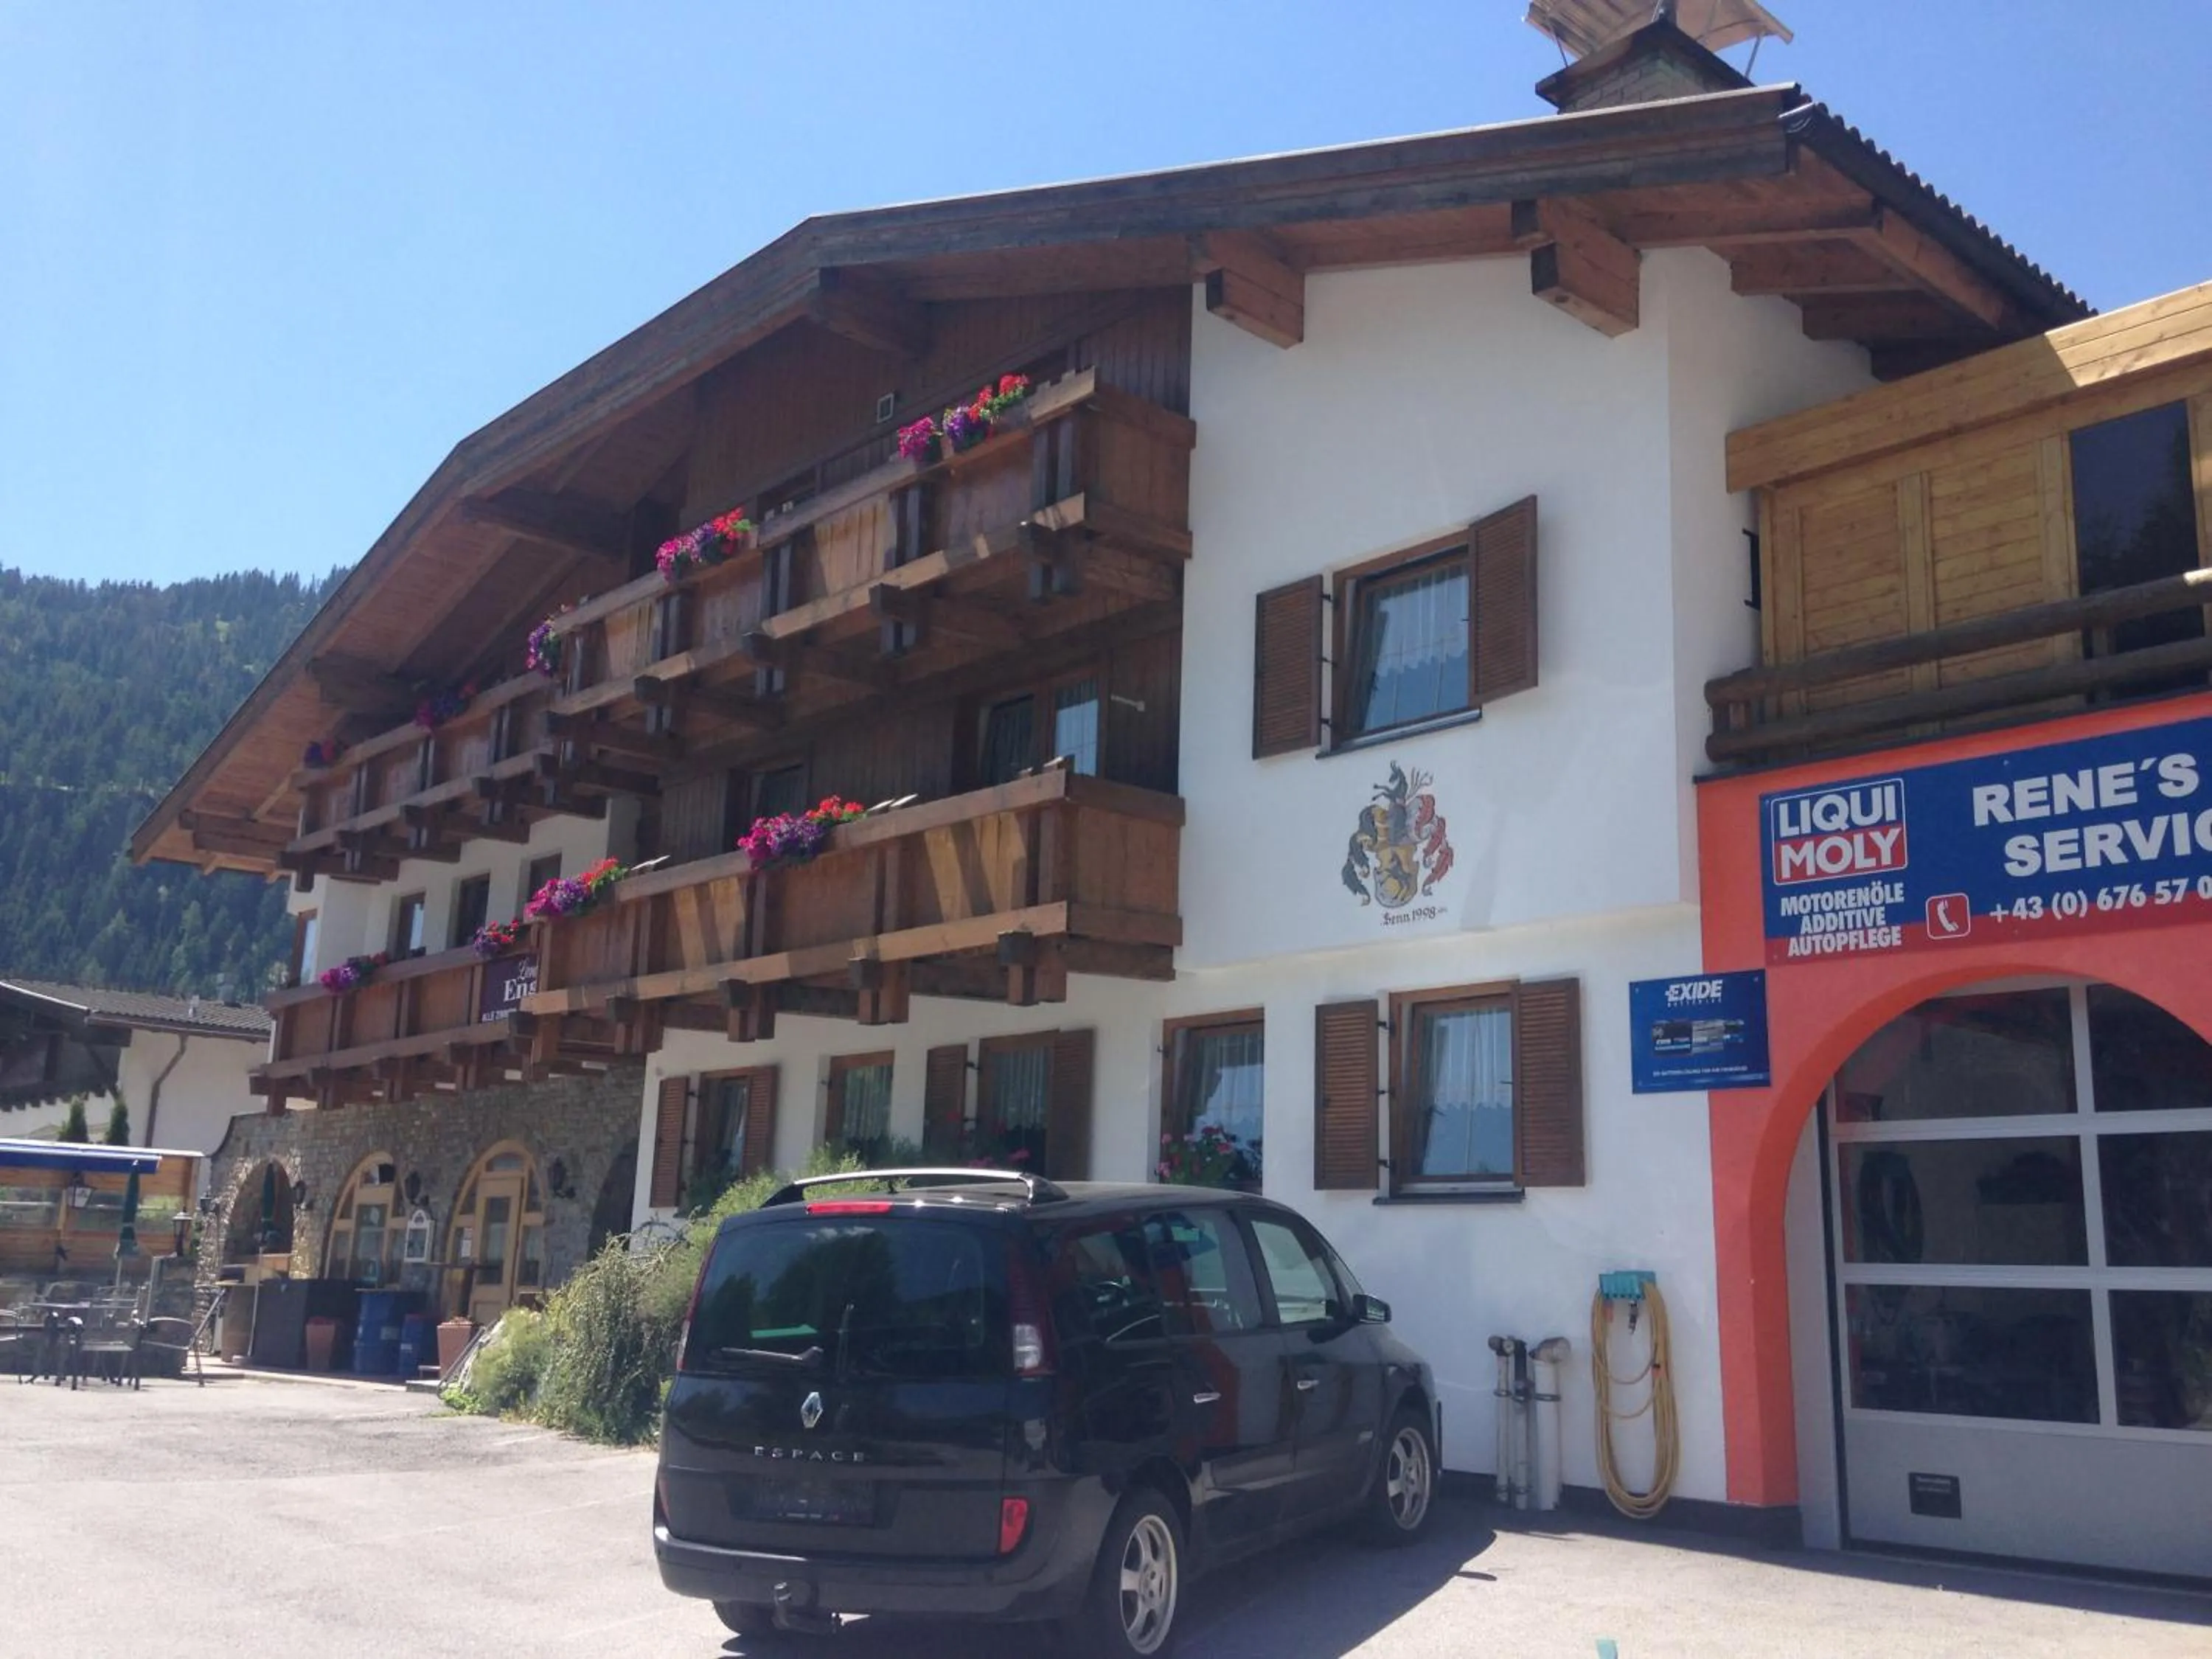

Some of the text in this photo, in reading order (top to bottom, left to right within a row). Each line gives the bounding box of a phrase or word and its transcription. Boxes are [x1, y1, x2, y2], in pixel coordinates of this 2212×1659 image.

[1779, 785, 1896, 838] LIQUI
[1781, 827, 1901, 880] MOLY
[1781, 880, 1905, 917] MOTORENÖLE
[1989, 896, 2044, 922] +43
[2051, 890, 2088, 919] (0)
[2097, 883, 2147, 911] 676
[2154, 877, 2189, 905] 57
[1800, 906, 1886, 935] ADDITIVE
[1788, 925, 1902, 957] AUTOPFLEGE
[1665, 979, 1723, 1002] EXIDE
[754, 1446, 865, 1462] ESPACE
